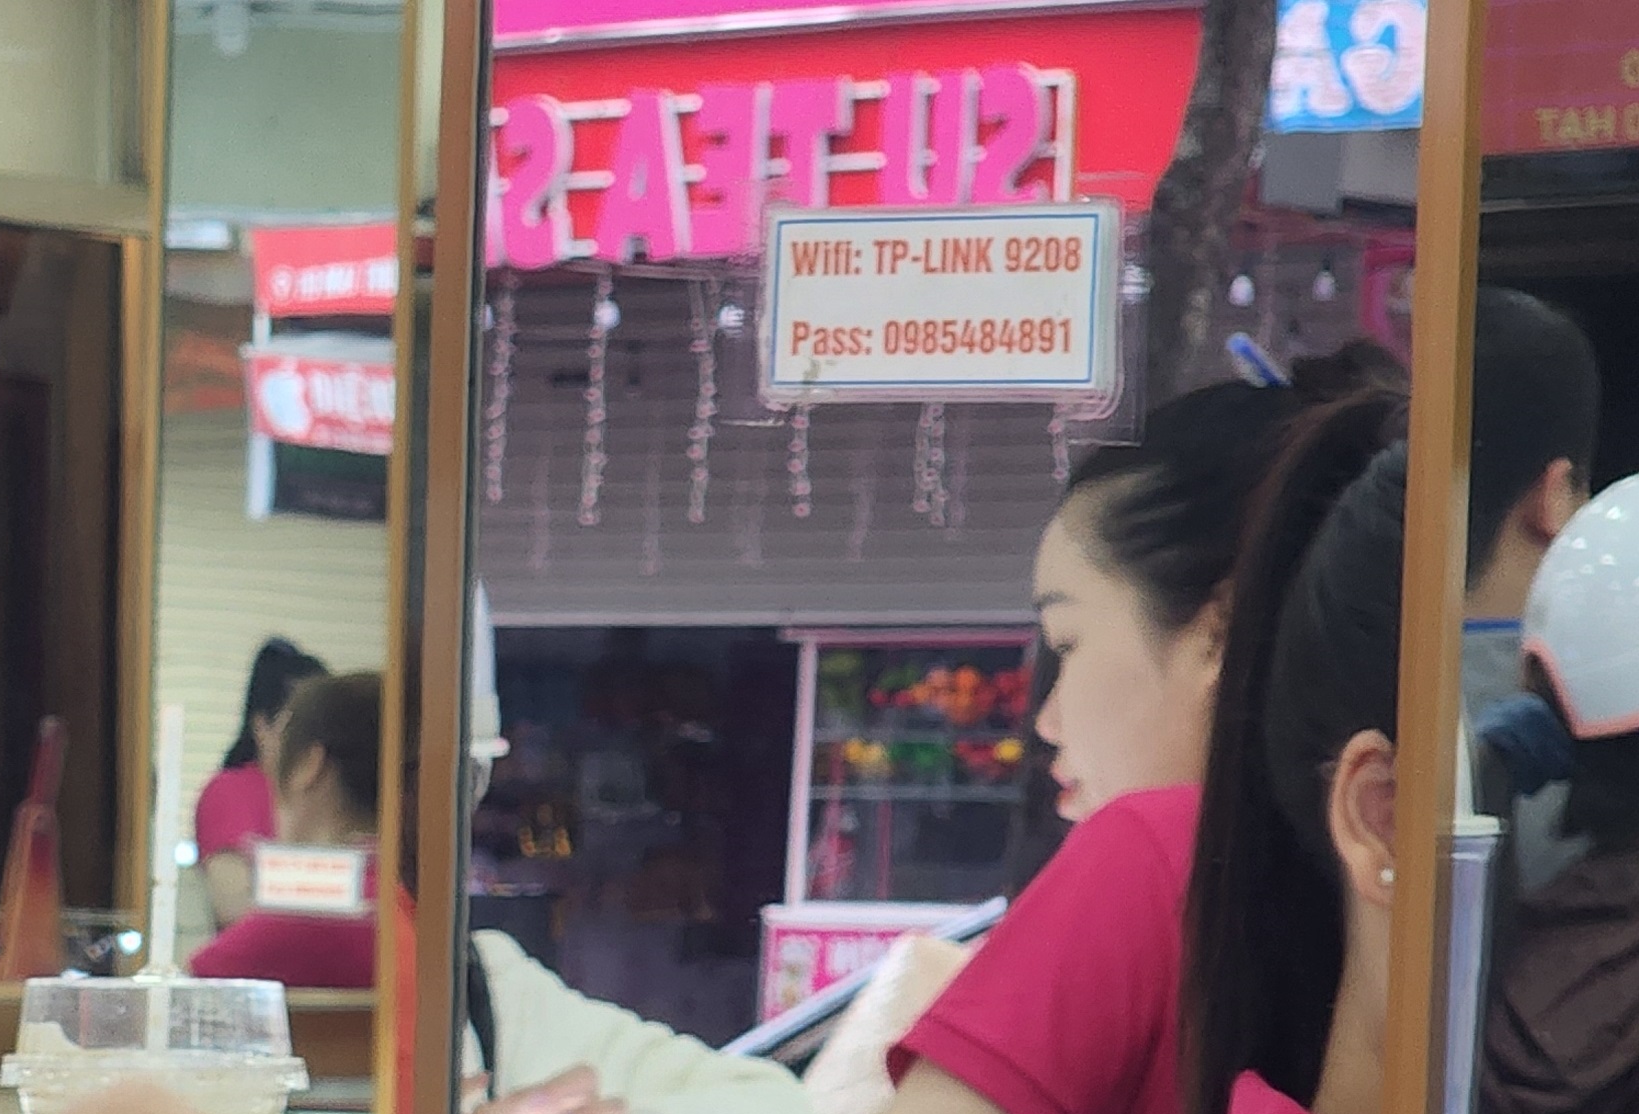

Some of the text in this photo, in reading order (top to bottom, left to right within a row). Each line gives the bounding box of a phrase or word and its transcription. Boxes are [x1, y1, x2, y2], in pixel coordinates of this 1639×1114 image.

[791, 236, 1082, 276] Wifi: TP-LINK 9208
[791, 317, 1072, 356] Pass: 0985484891
